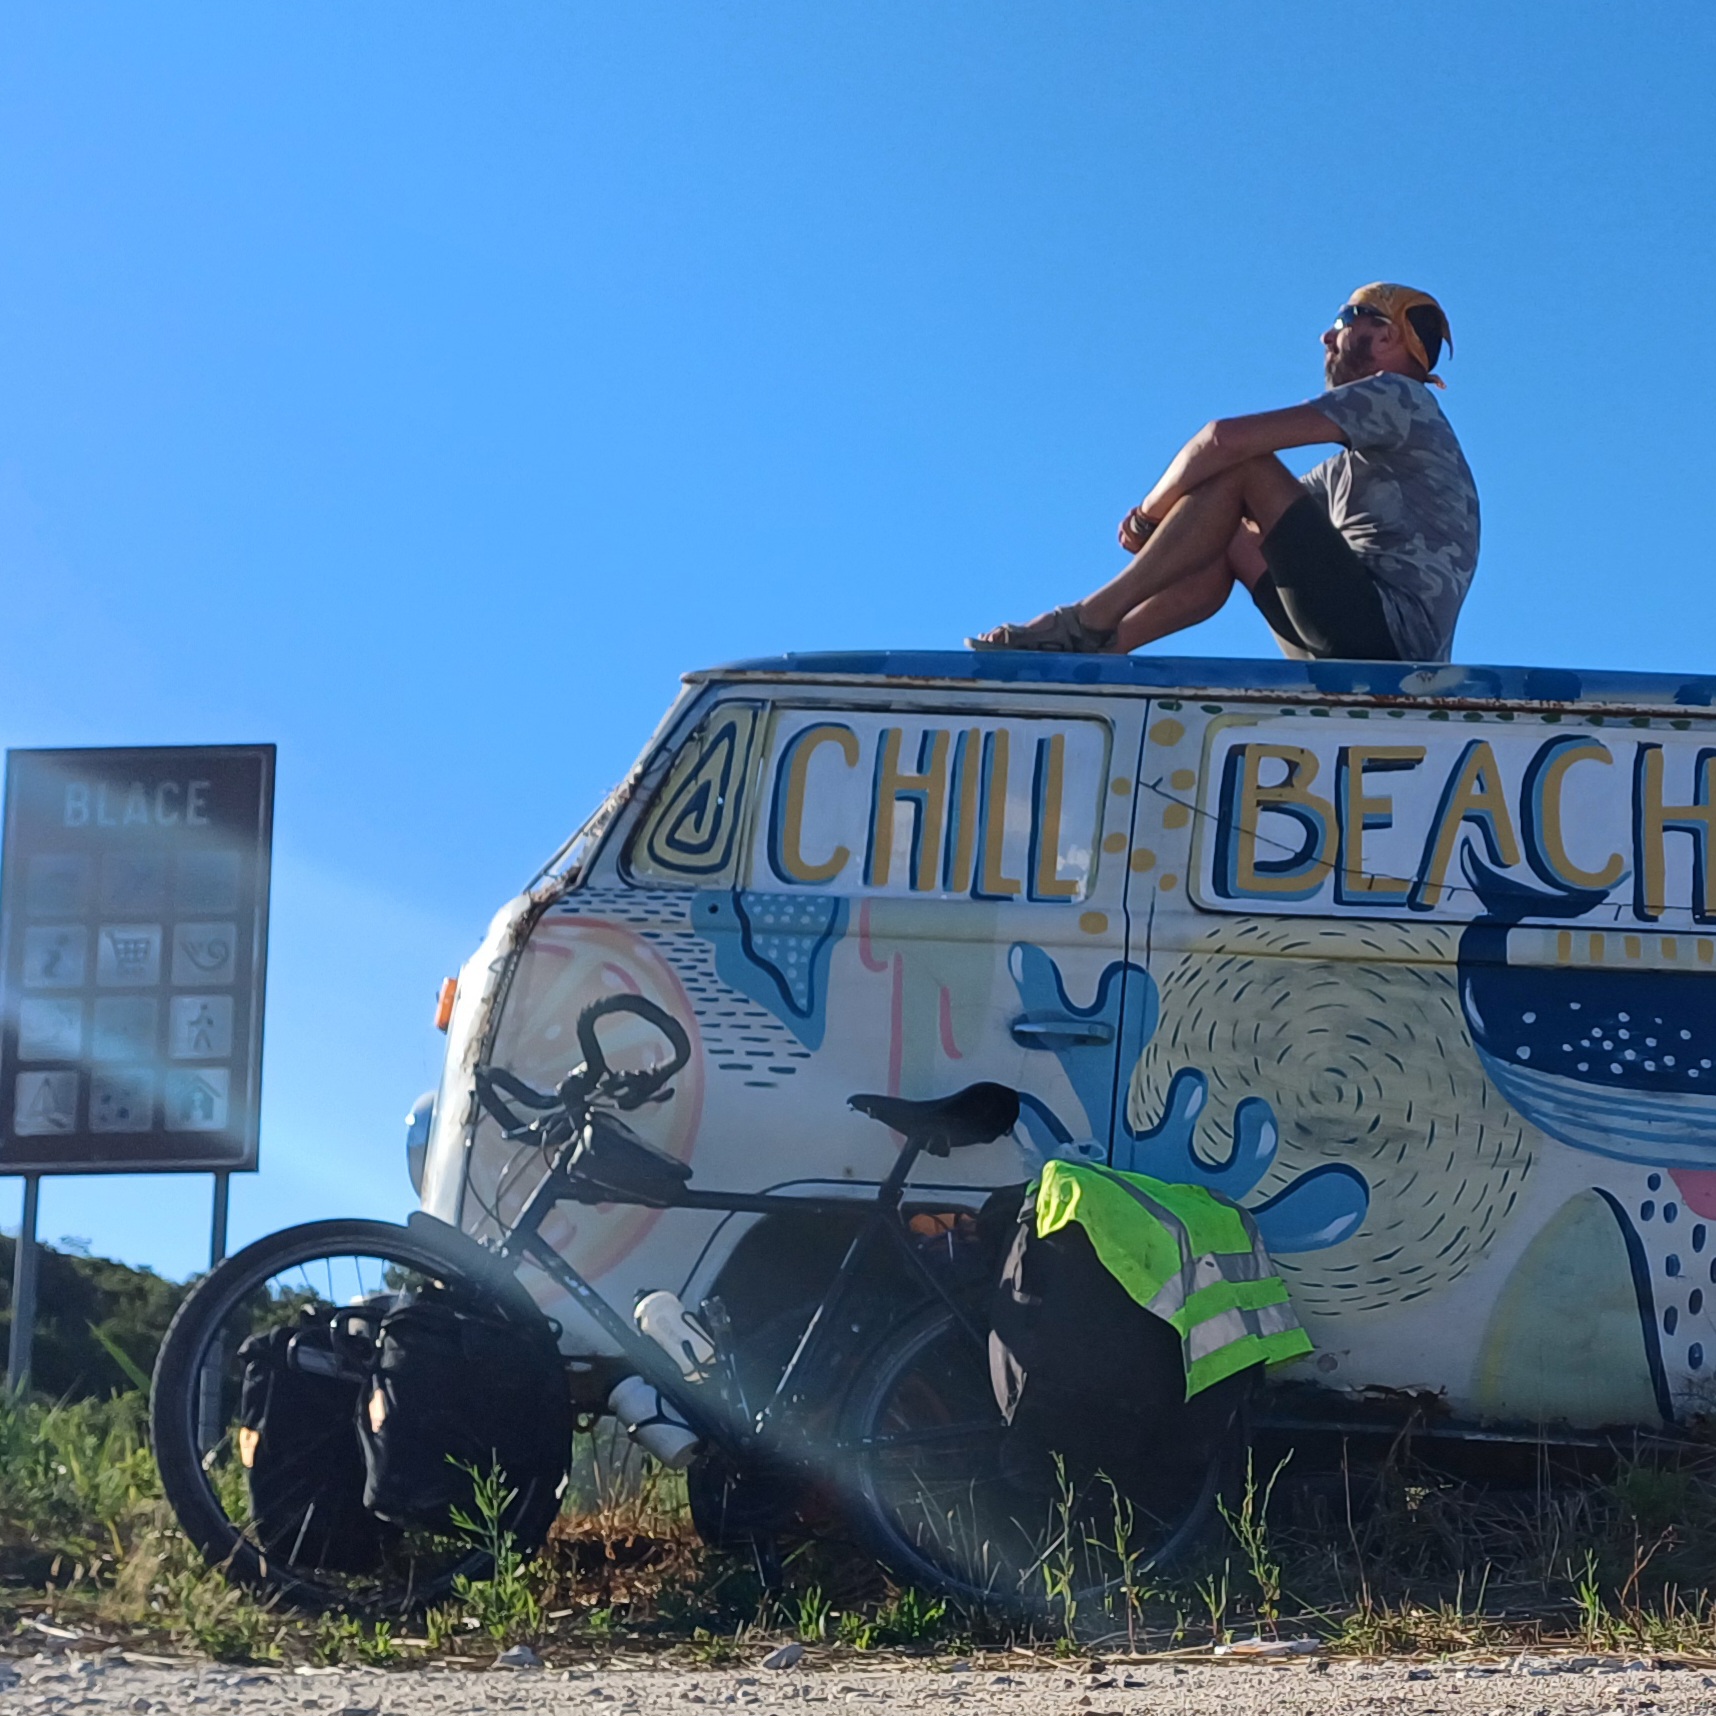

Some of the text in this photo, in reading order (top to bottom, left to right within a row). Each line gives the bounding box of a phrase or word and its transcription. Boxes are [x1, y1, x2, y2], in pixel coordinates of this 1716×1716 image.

[63, 779, 211, 828] BLACE
[767, 721, 1716, 924] CHILL BEACH
